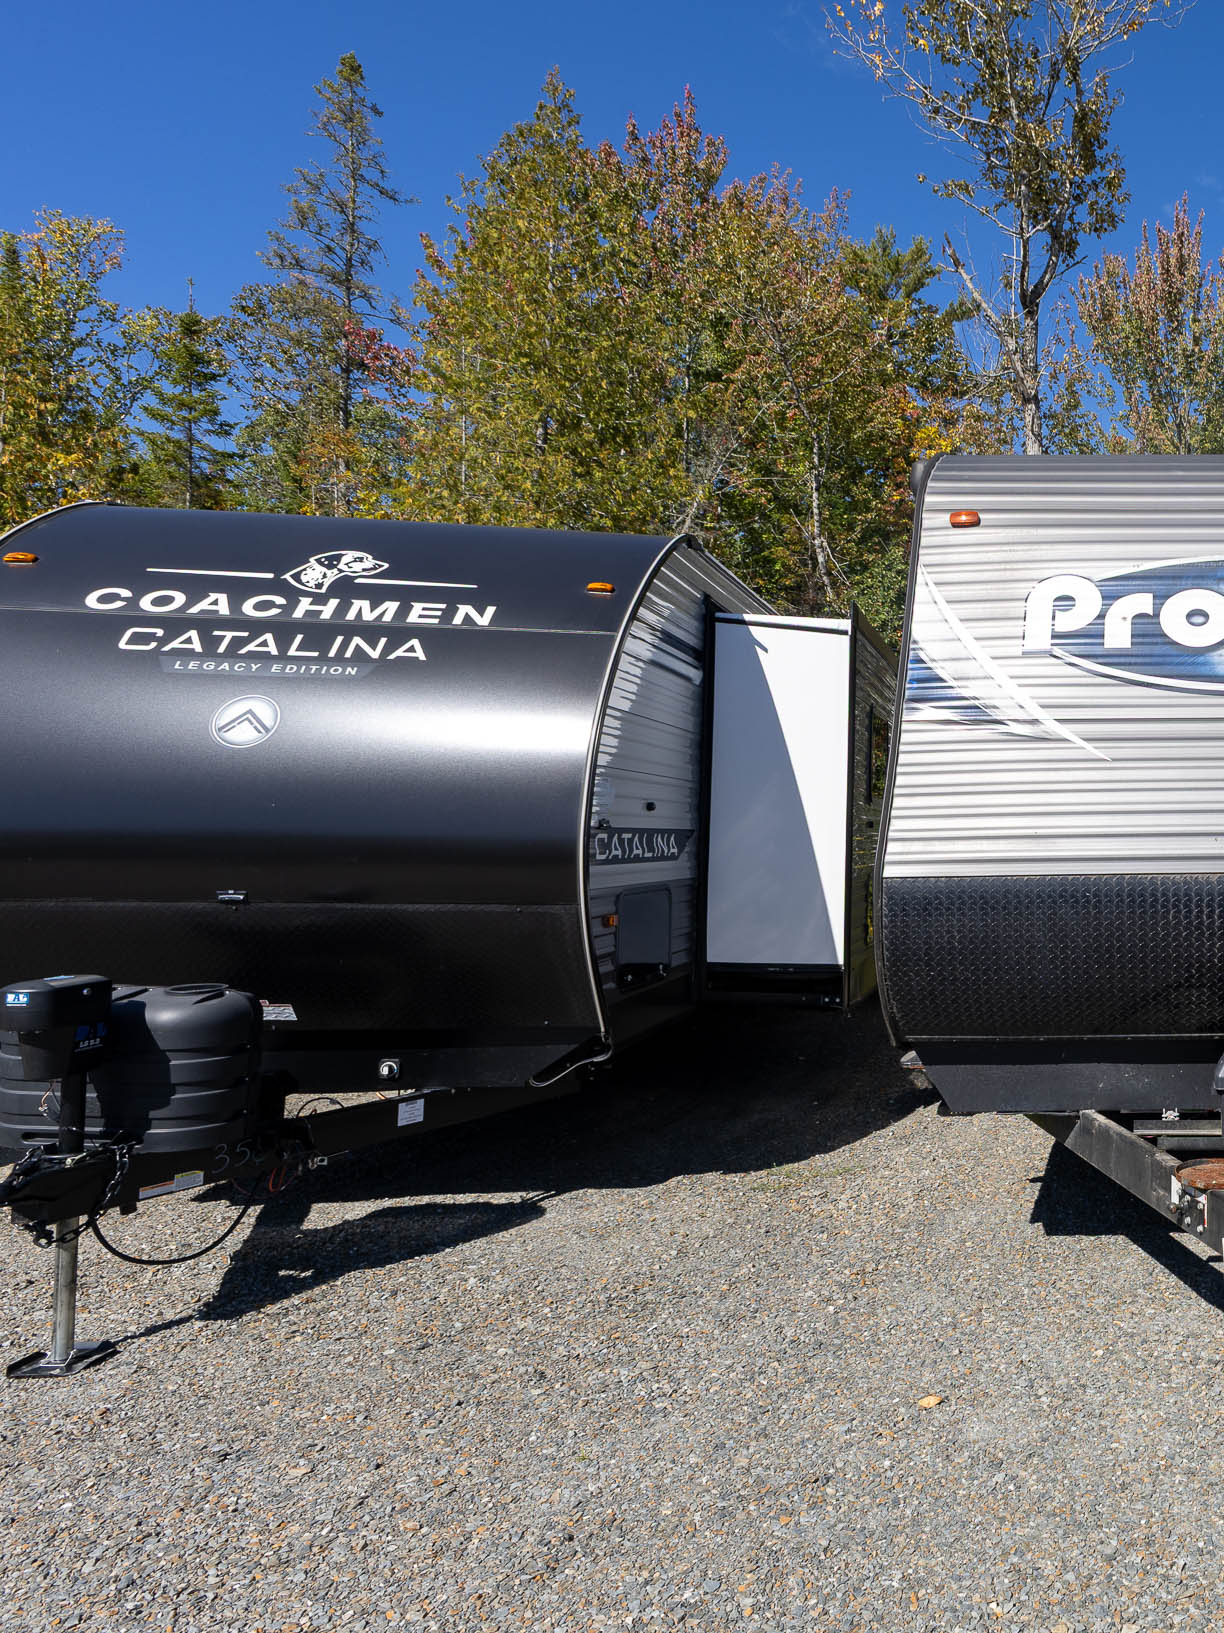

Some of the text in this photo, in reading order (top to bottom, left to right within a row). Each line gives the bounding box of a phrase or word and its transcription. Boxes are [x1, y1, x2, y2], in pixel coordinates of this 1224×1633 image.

[84, 587, 497, 626] COACHMEN
[118, 627, 427, 661] CATALINA
[174, 660, 357, 675] LEGACY EDITION
[595, 833, 678, 860] CATALINA
